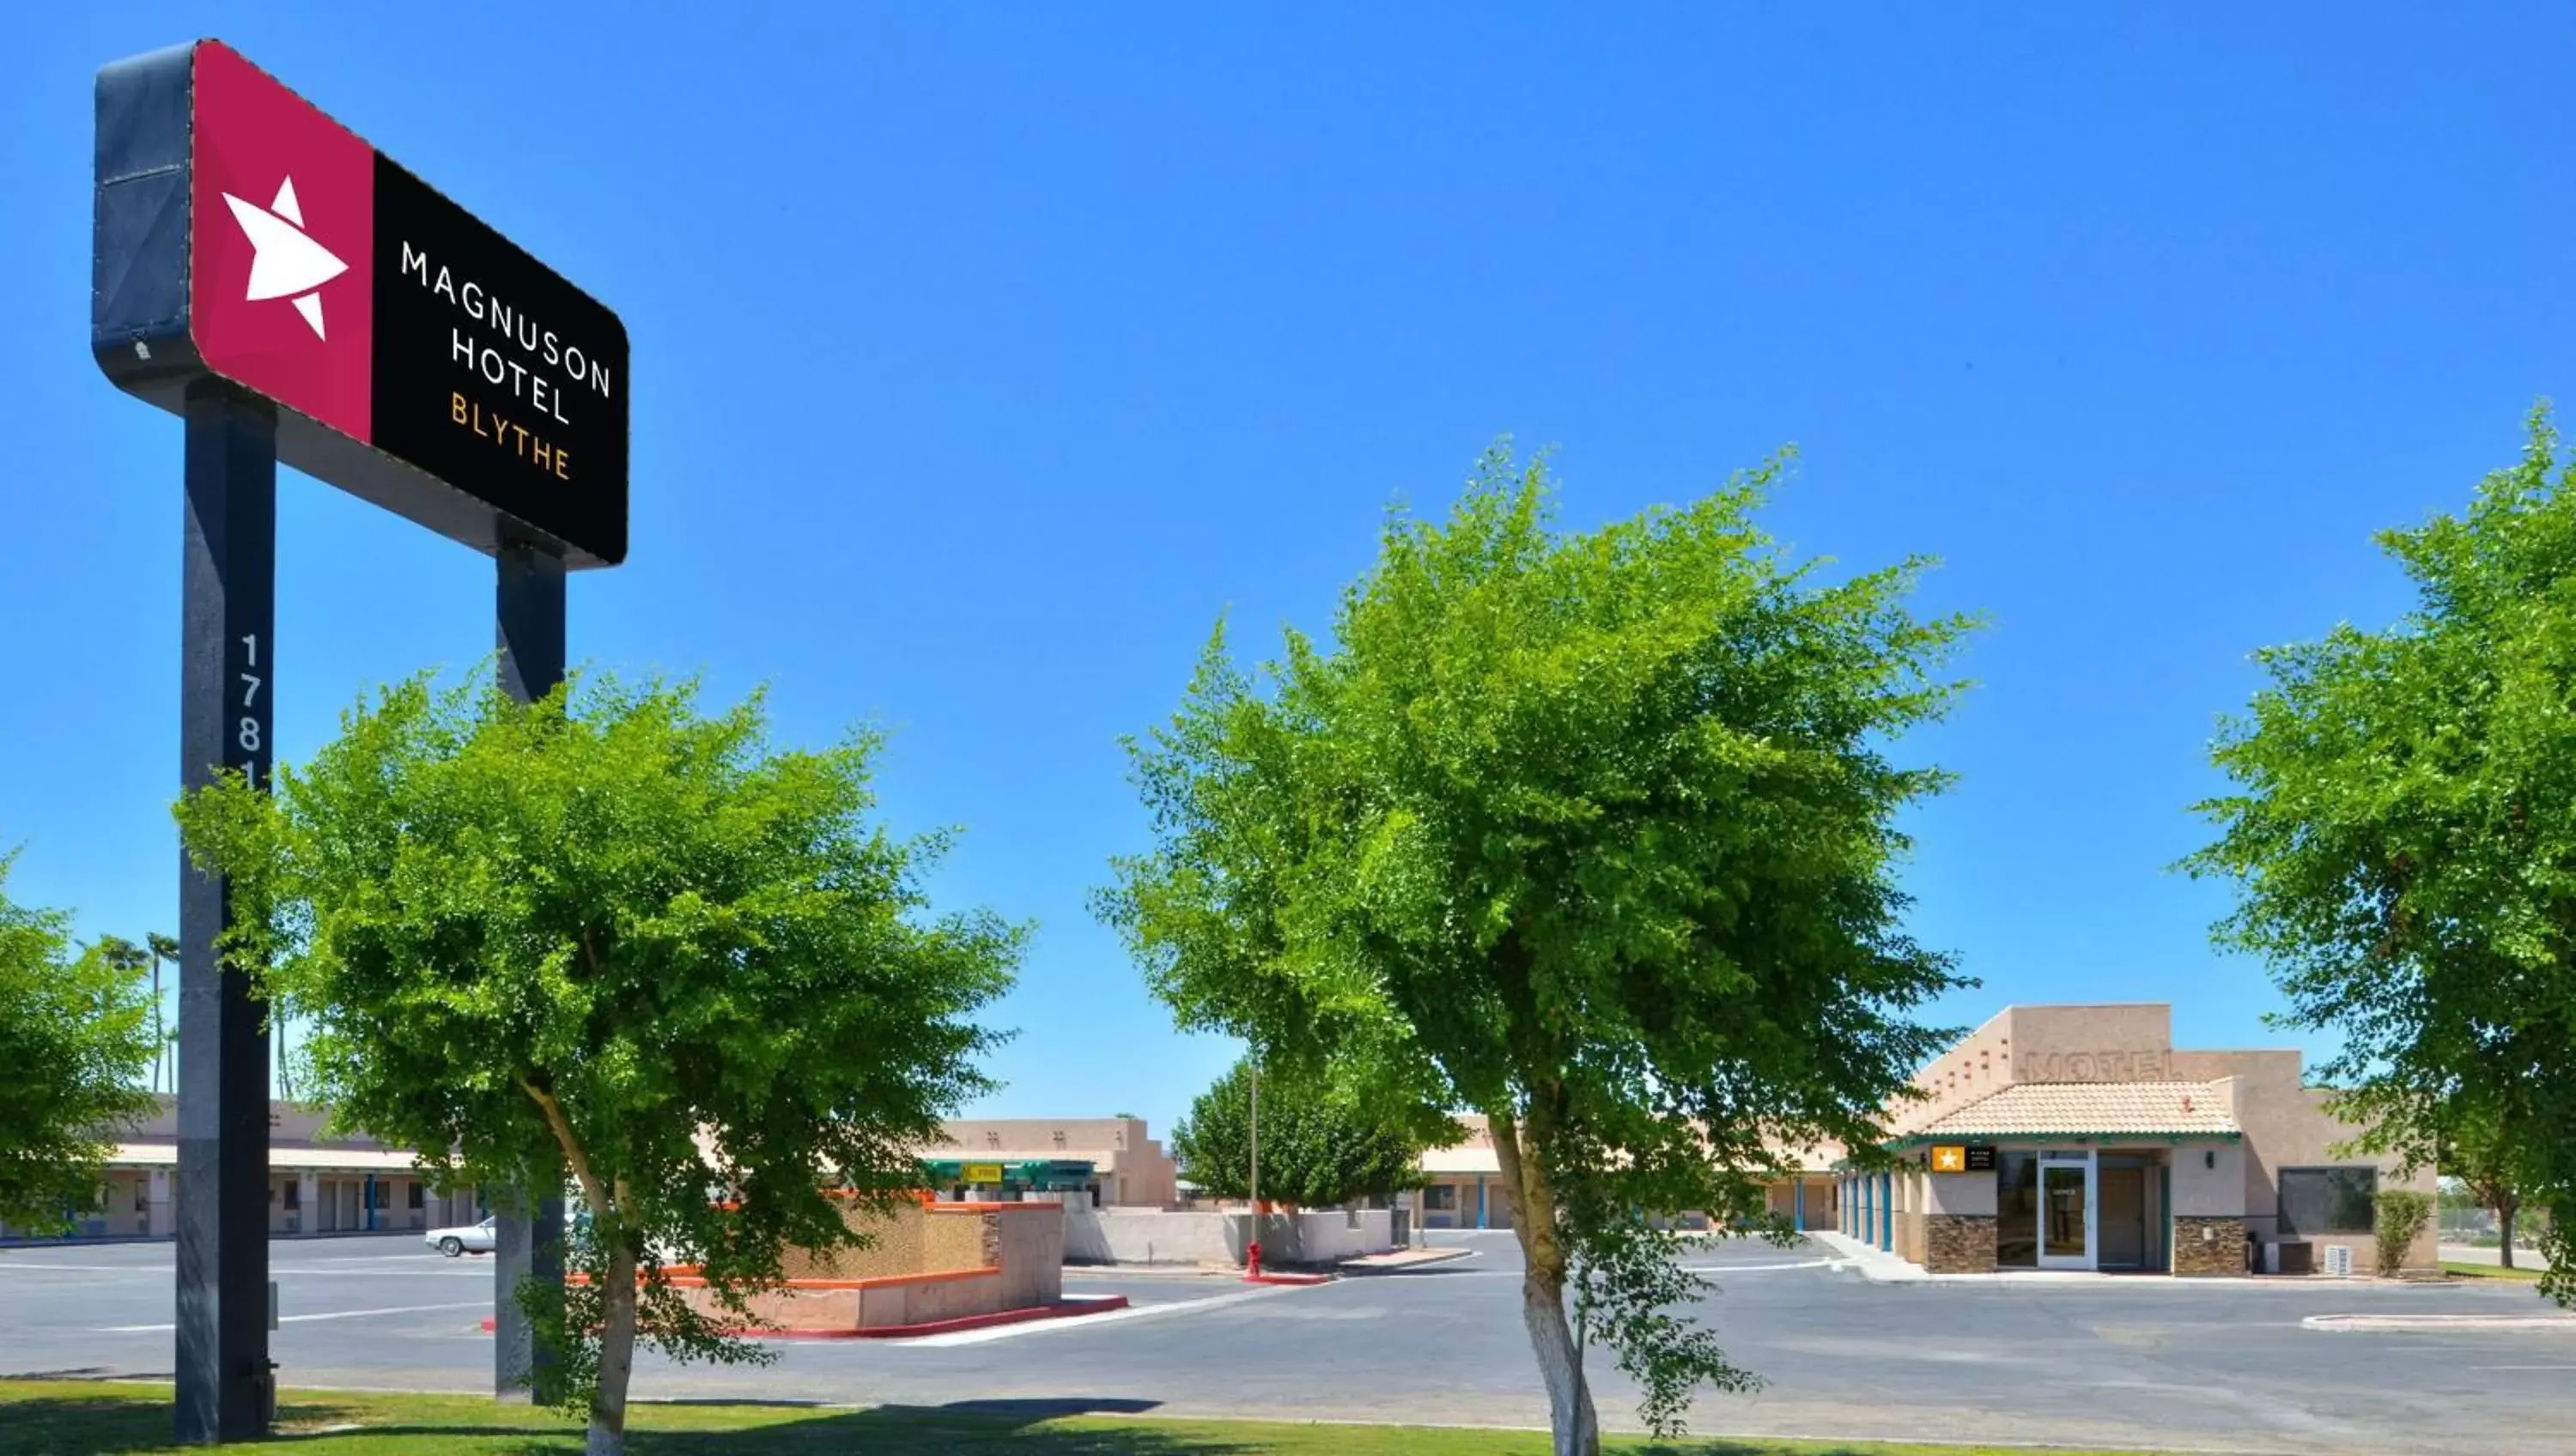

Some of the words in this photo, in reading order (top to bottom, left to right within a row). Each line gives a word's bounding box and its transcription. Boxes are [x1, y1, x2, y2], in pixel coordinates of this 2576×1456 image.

[401, 240, 610, 398] MAGNUSON
[452, 327, 569, 425] HOTEL
[452, 391, 569, 480] BLYTHE
[2023, 1048, 2184, 1082] MOTEL
